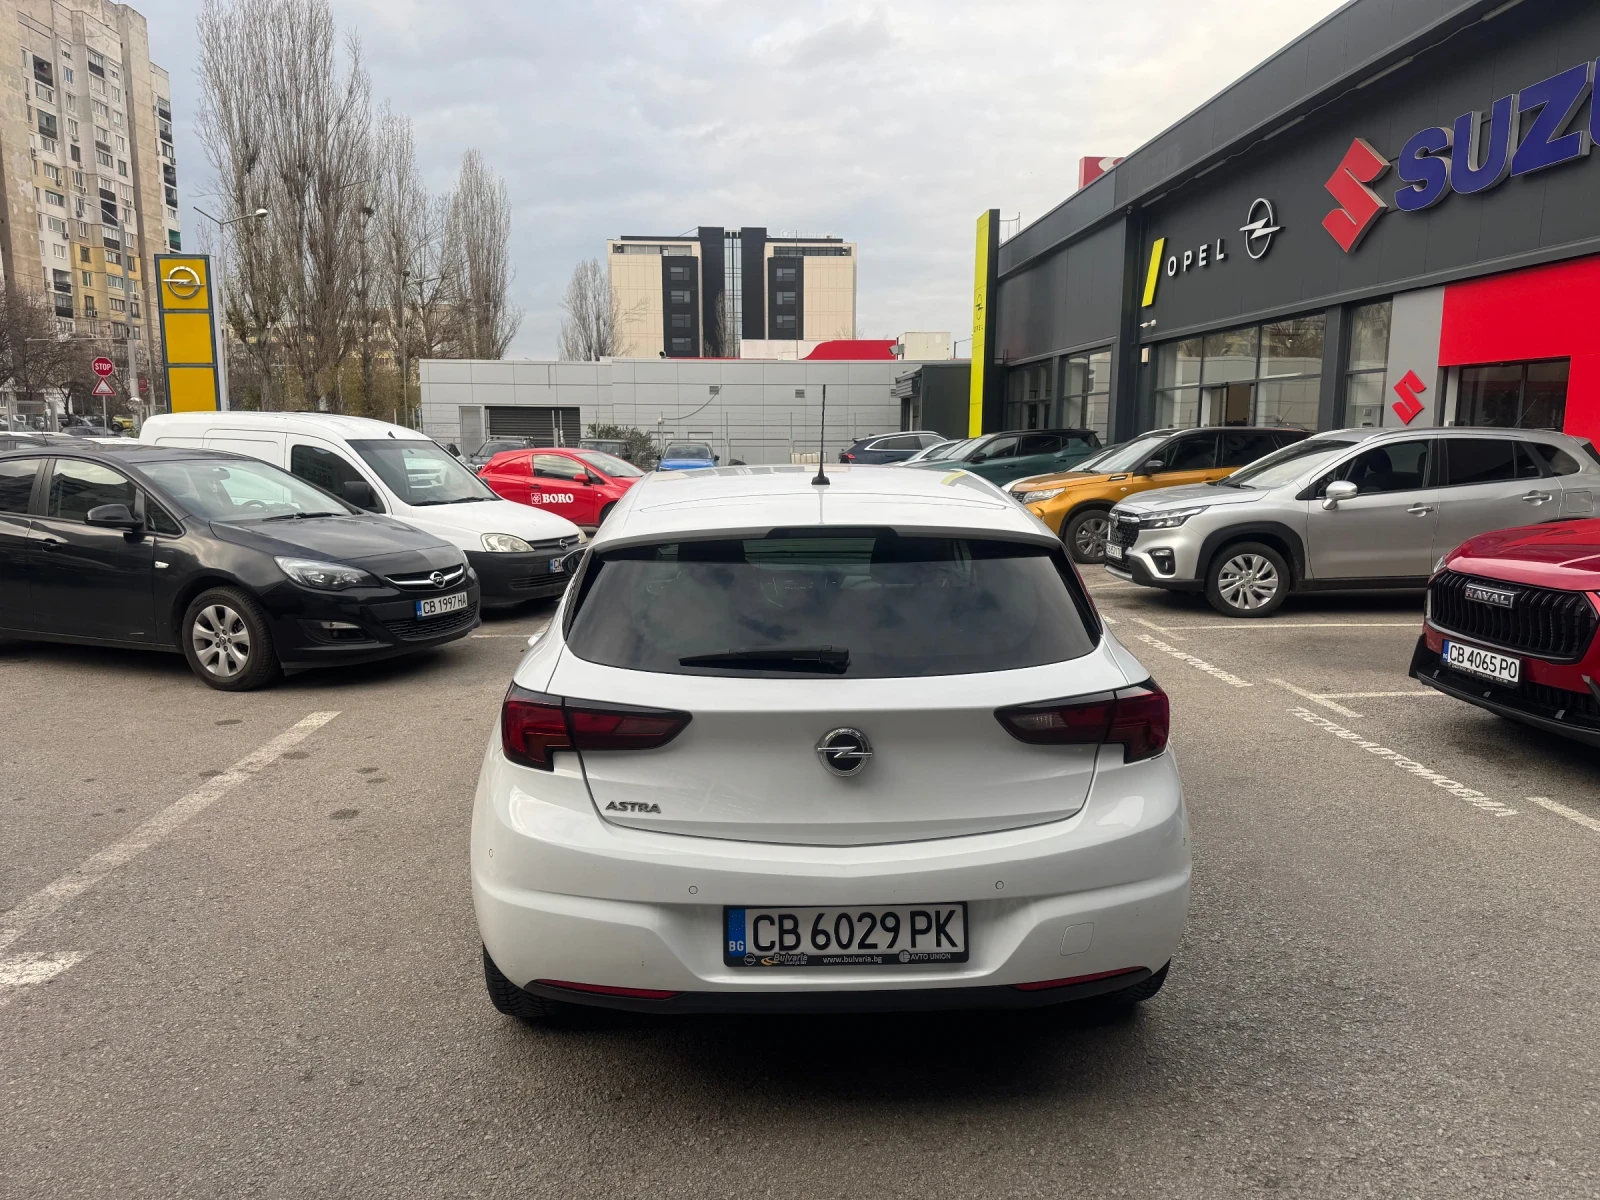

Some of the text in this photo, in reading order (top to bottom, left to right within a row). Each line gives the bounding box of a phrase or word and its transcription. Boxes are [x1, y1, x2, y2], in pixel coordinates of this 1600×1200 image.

[1395, 56, 1600, 212] SUZ
[1168, 238, 1225, 277] OPEL
[94, 362, 112, 371] STOP
[541, 493, 574, 504] BORO
[1465, 587, 1509, 605] HAVAL
[422, 593, 467, 615] CB 1997 HA
[1449, 645, 1465, 664] CB
[1467, 649, 1497, 674] 4065
[1499, 658, 1518, 679] PO
[605, 801, 662, 814] ASTRA
[752, 910, 959, 952] CB 6029 PK
[728, 940, 744, 952] BG
[773, 952, 808, 962] Bulvaria
[822, 955, 883, 964] www.bulvaria.bg
[910, 952, 951, 961] AVTO UNION
